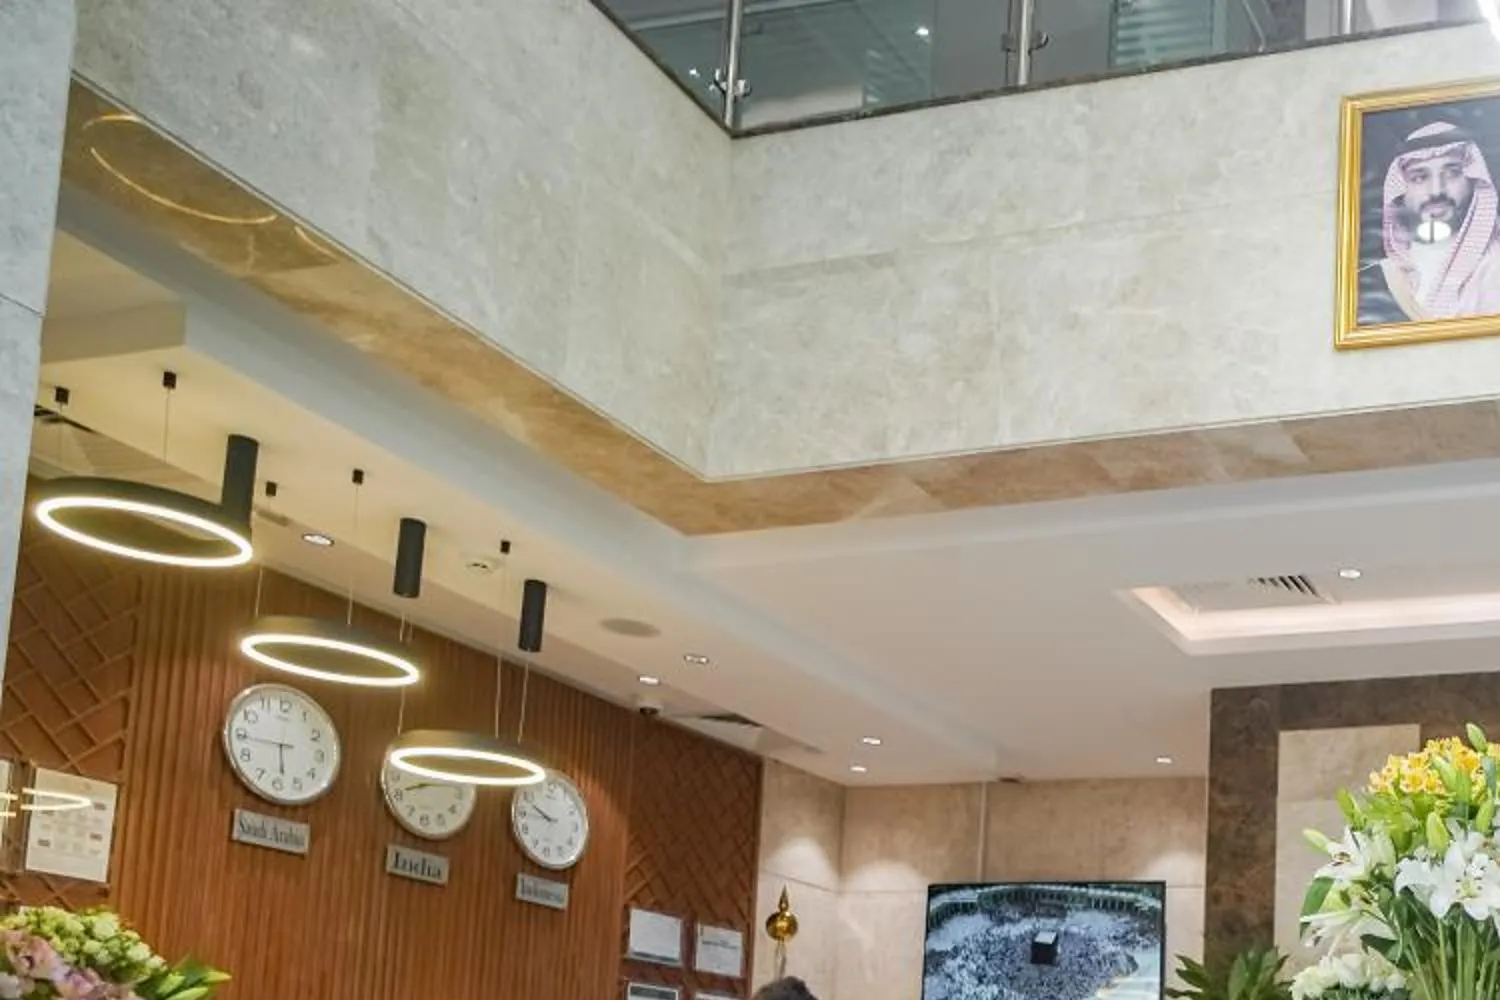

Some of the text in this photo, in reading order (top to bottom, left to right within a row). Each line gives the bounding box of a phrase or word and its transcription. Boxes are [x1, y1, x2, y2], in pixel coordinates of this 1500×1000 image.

[259, 696, 272, 712] 11
[279, 698, 292, 714] 12
[243, 707, 259, 725] 10
[302, 710, 307, 723] 1
[234, 726, 247, 742] 9
[310, 727, 321, 743] 2
[239, 747, 252, 763] 8
[313, 747, 325, 765] 3
[254, 766, 267, 781] 7
[306, 766, 317, 781] 4
[271, 777, 284, 793] 6
[239, 818, 306, 849] Saudi Arabia
[393, 851, 442, 880] India
